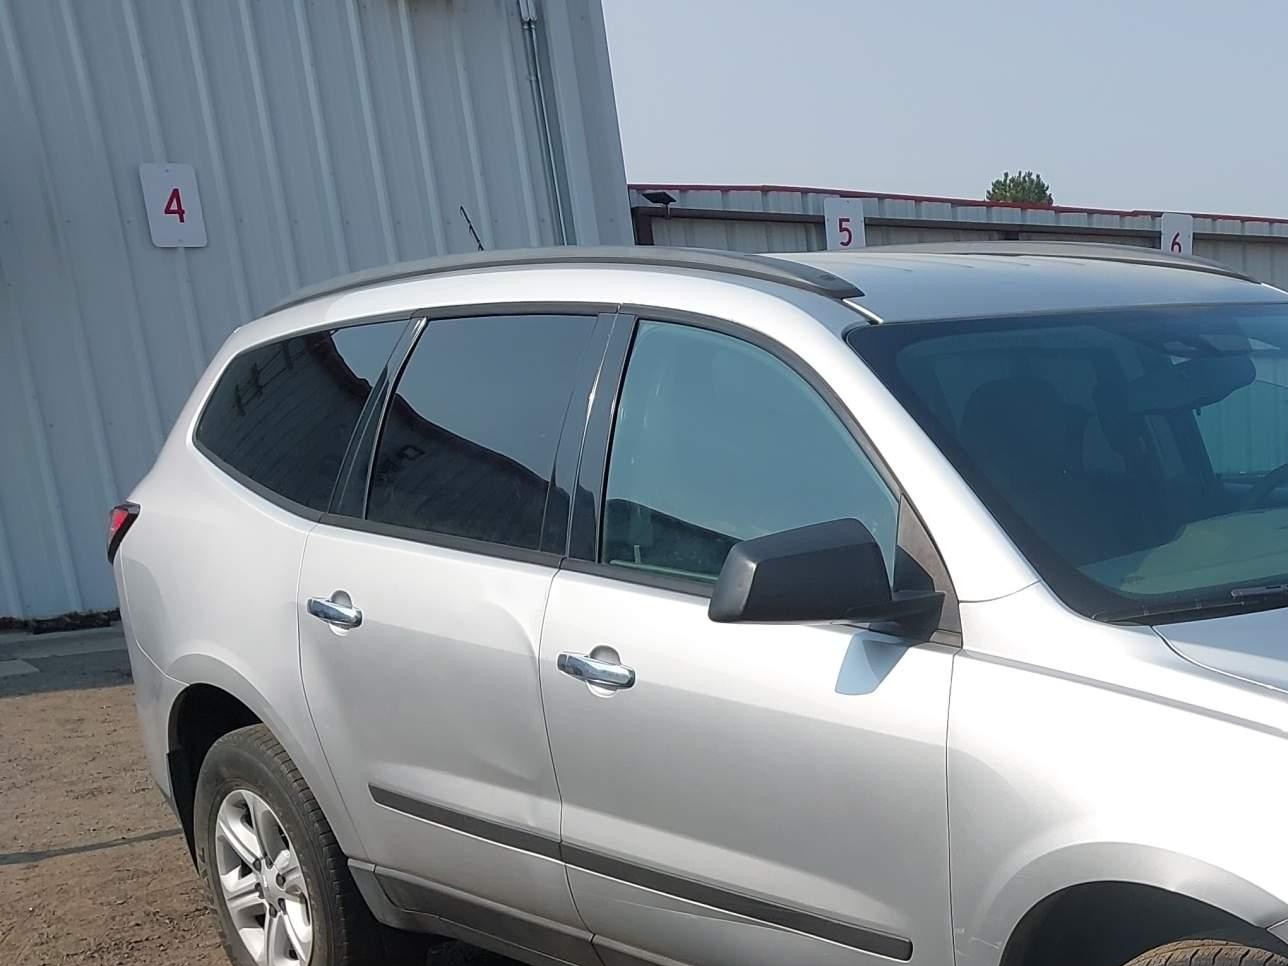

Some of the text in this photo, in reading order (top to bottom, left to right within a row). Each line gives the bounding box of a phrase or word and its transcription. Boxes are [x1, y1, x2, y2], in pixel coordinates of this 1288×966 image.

[164, 188, 185, 223] 4
[838, 217, 852, 247] 5
[1171, 232, 1182, 254] 6
